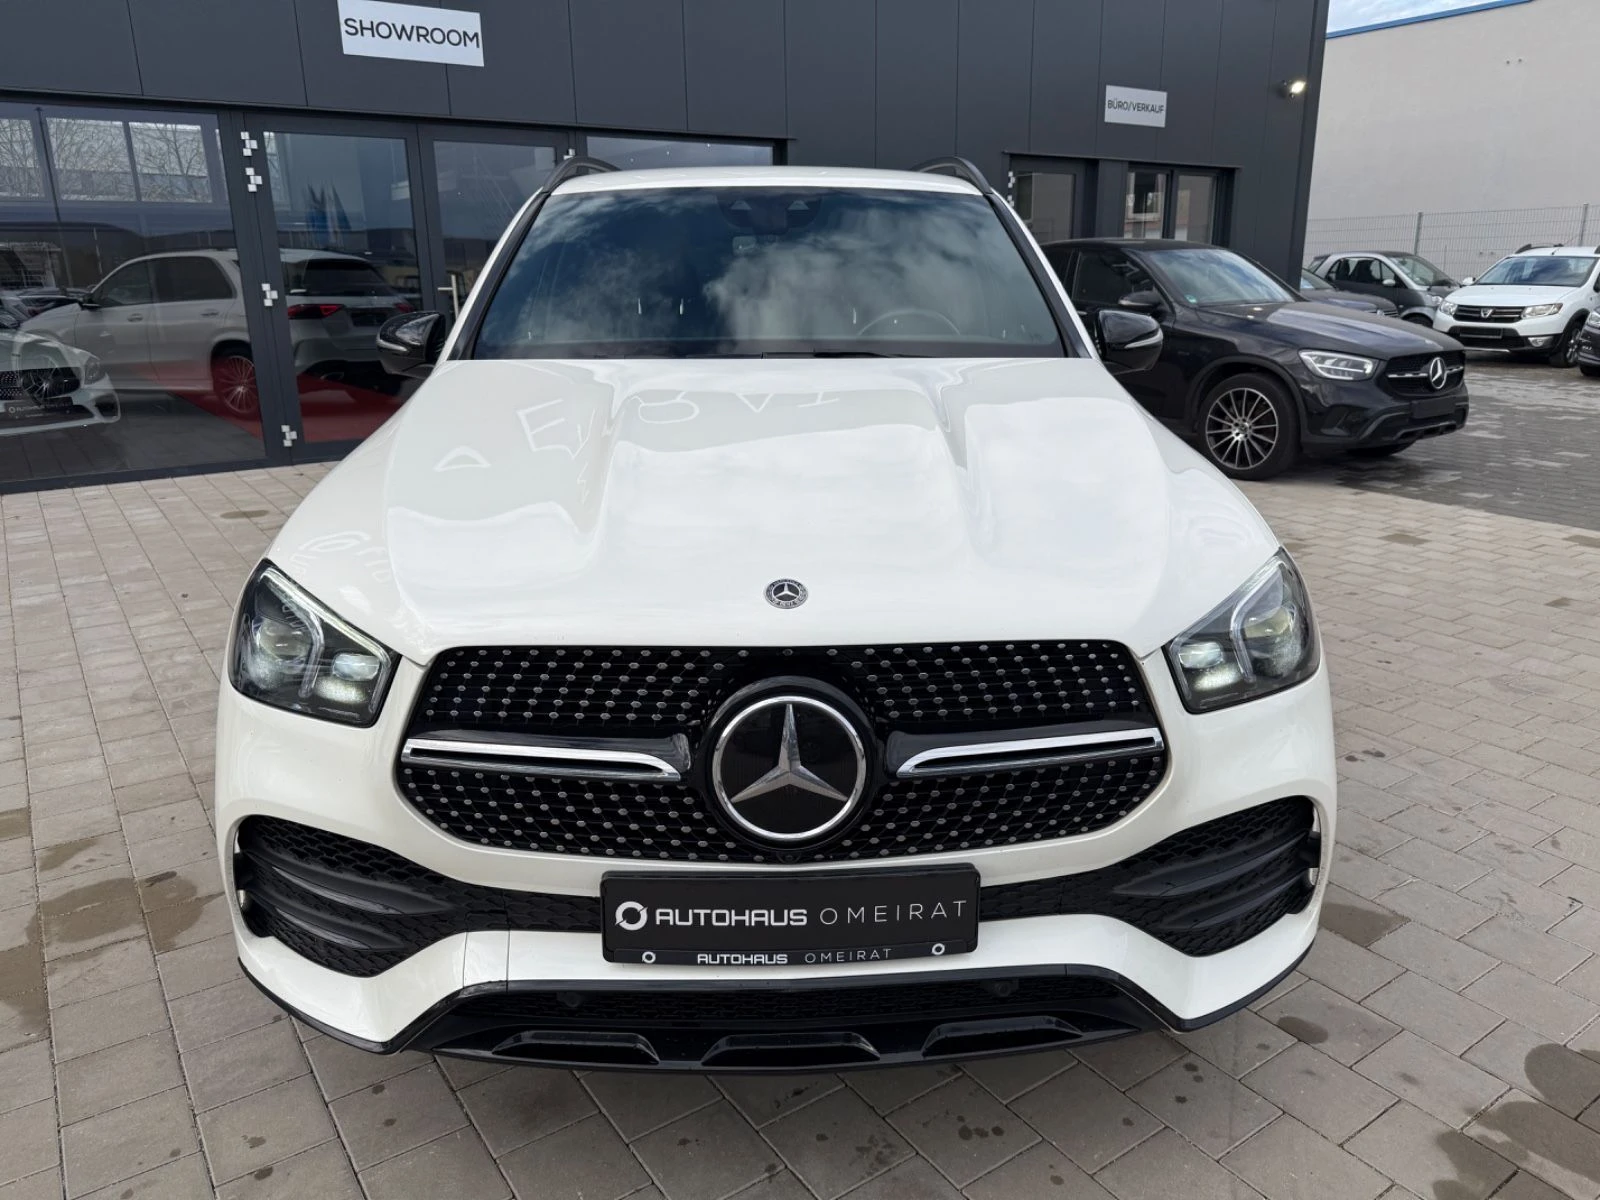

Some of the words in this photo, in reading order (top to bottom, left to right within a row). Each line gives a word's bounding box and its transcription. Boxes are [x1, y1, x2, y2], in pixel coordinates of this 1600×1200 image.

[343, 17, 480, 49] SHOWROOM
[1107, 98, 1165, 113] BÜRO/VERKAUF
[655, 907, 808, 927] AUTOHAUS
[819, 900, 967, 926] OMEIRAT
[697, 953, 788, 965] AUTOHAUS
[804, 948, 892, 964] OMEIRAT
